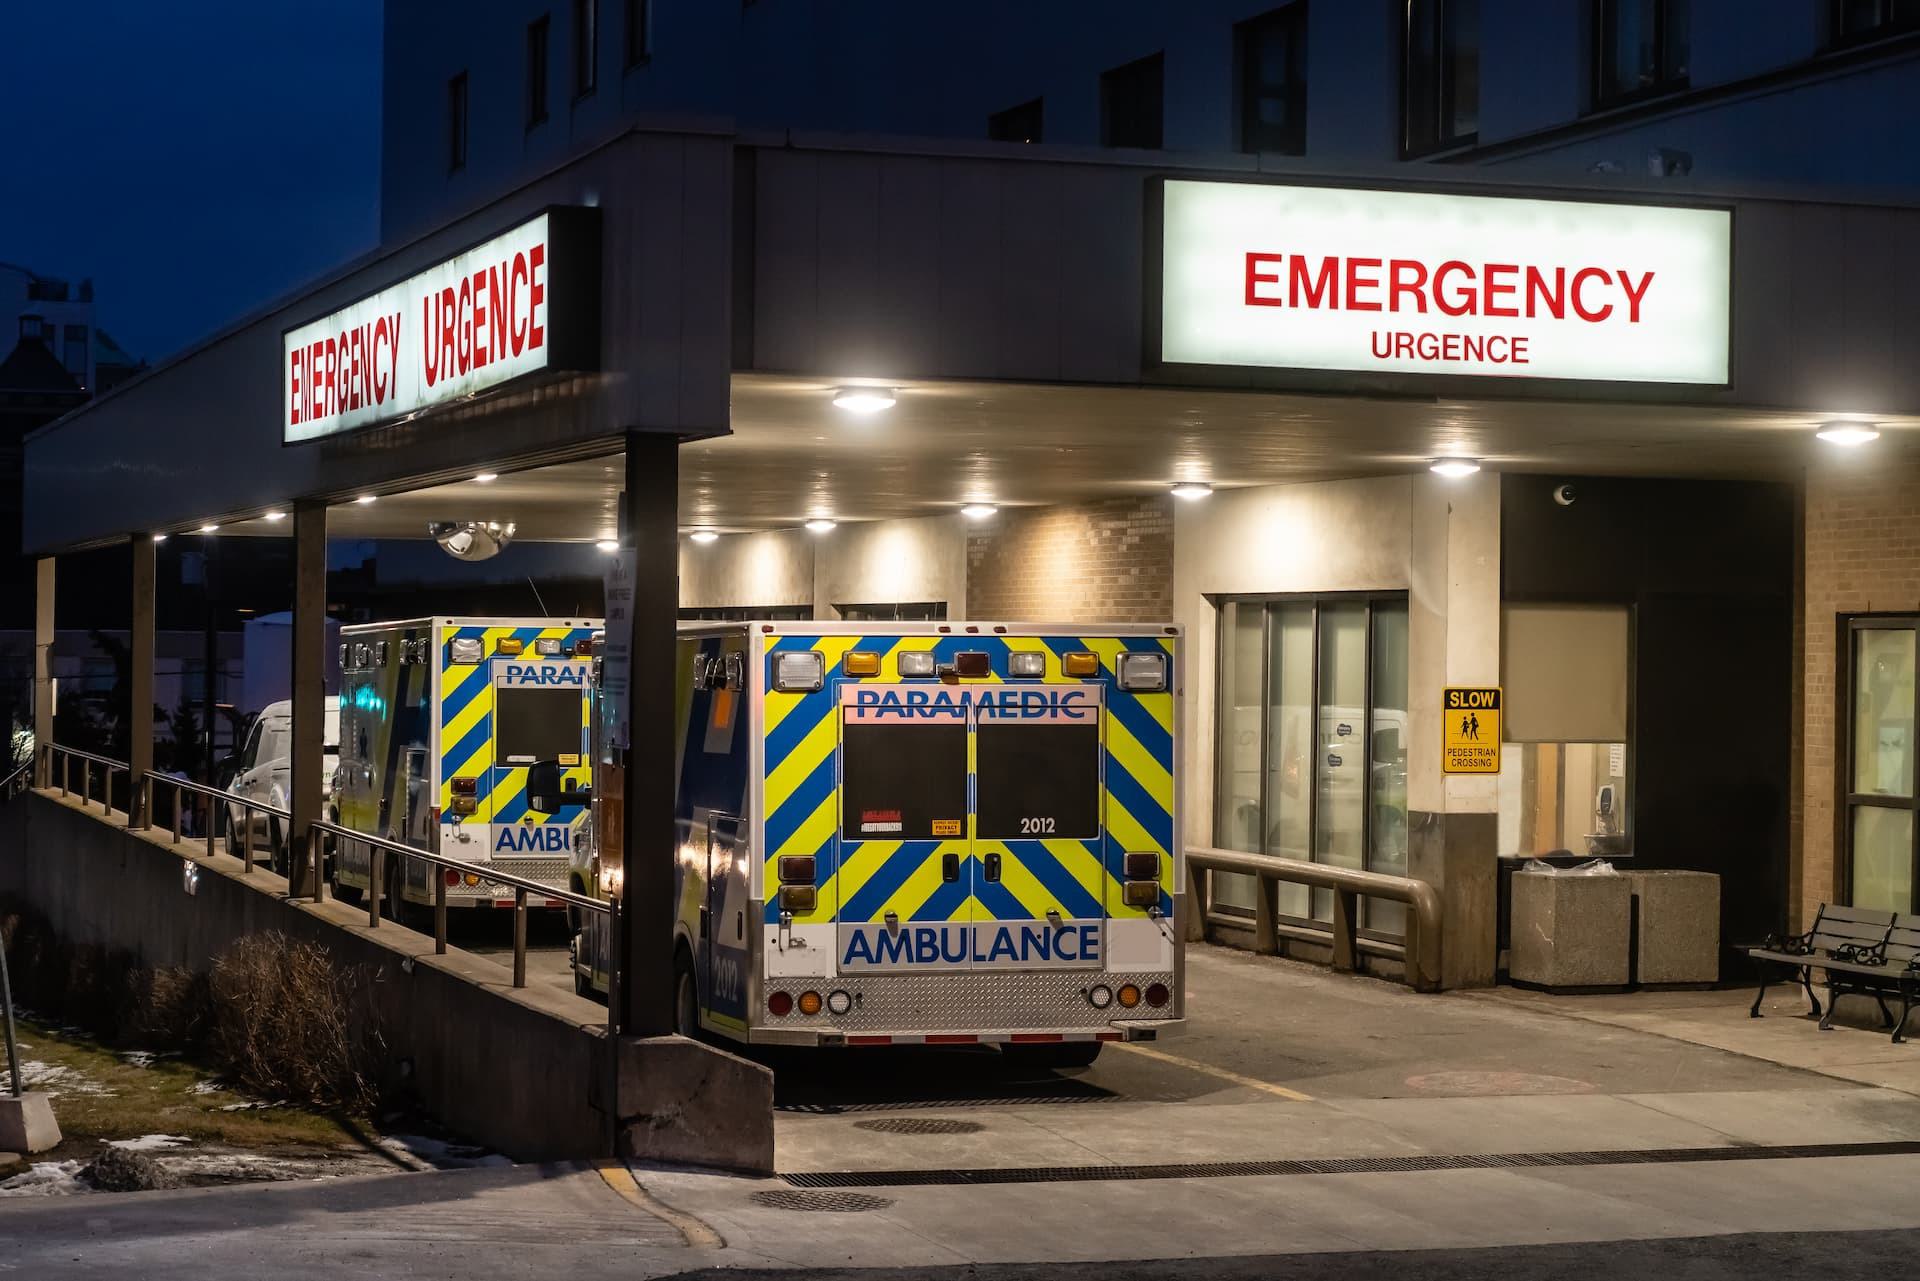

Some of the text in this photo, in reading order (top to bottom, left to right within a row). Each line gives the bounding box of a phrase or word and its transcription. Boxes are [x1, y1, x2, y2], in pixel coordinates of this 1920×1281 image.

[1244, 252, 1656, 323] EMERGENCY
[290, 243, 545, 426] EMERGENCY URGENCE
[1370, 331, 1530, 364] URGENCE
[856, 690, 1086, 719] PARAMEDIC
[1449, 691, 1495, 708] SLOW
[1447, 747, 1496, 757] PEDESTRIAN
[1451, 758, 1492, 768] CROSSING
[1020, 817, 1056, 834] 2012
[843, 925, 1100, 965] AMBULANCE
[714, 955, 739, 1003] 2012
